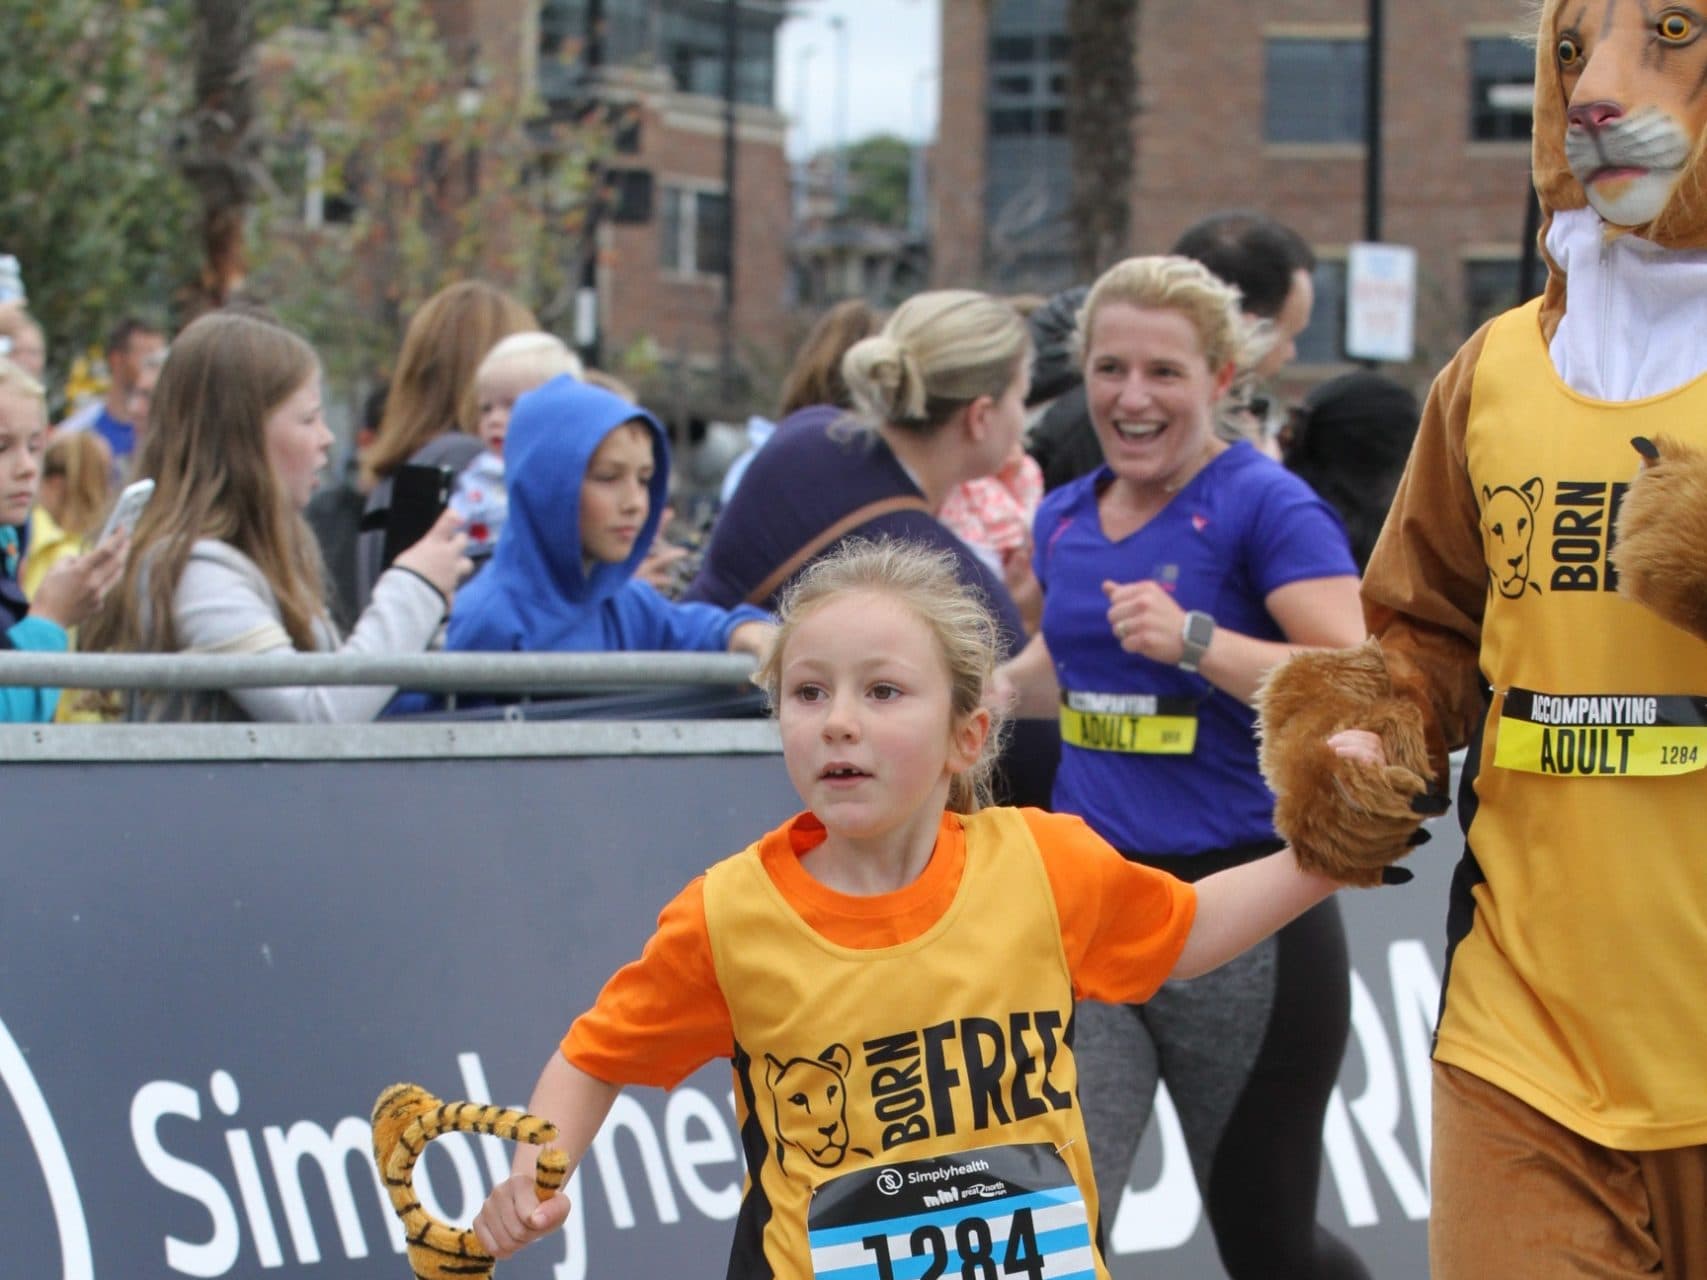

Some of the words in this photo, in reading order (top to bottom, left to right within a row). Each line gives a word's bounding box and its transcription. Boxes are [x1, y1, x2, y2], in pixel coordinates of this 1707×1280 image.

[1550, 481, 1607, 592] BORN
[1531, 694, 1657, 725] ACCOMPANYING
[1081, 714, 1138, 750] ADULT
[1541, 728, 1634, 774] ADULT
[1660, 746, 1698, 765] 1284
[862, 1030, 930, 1153] BORN
[922, 1010, 1073, 1137] FREE
[908, 1159, 990, 1185] Simplyhealth
